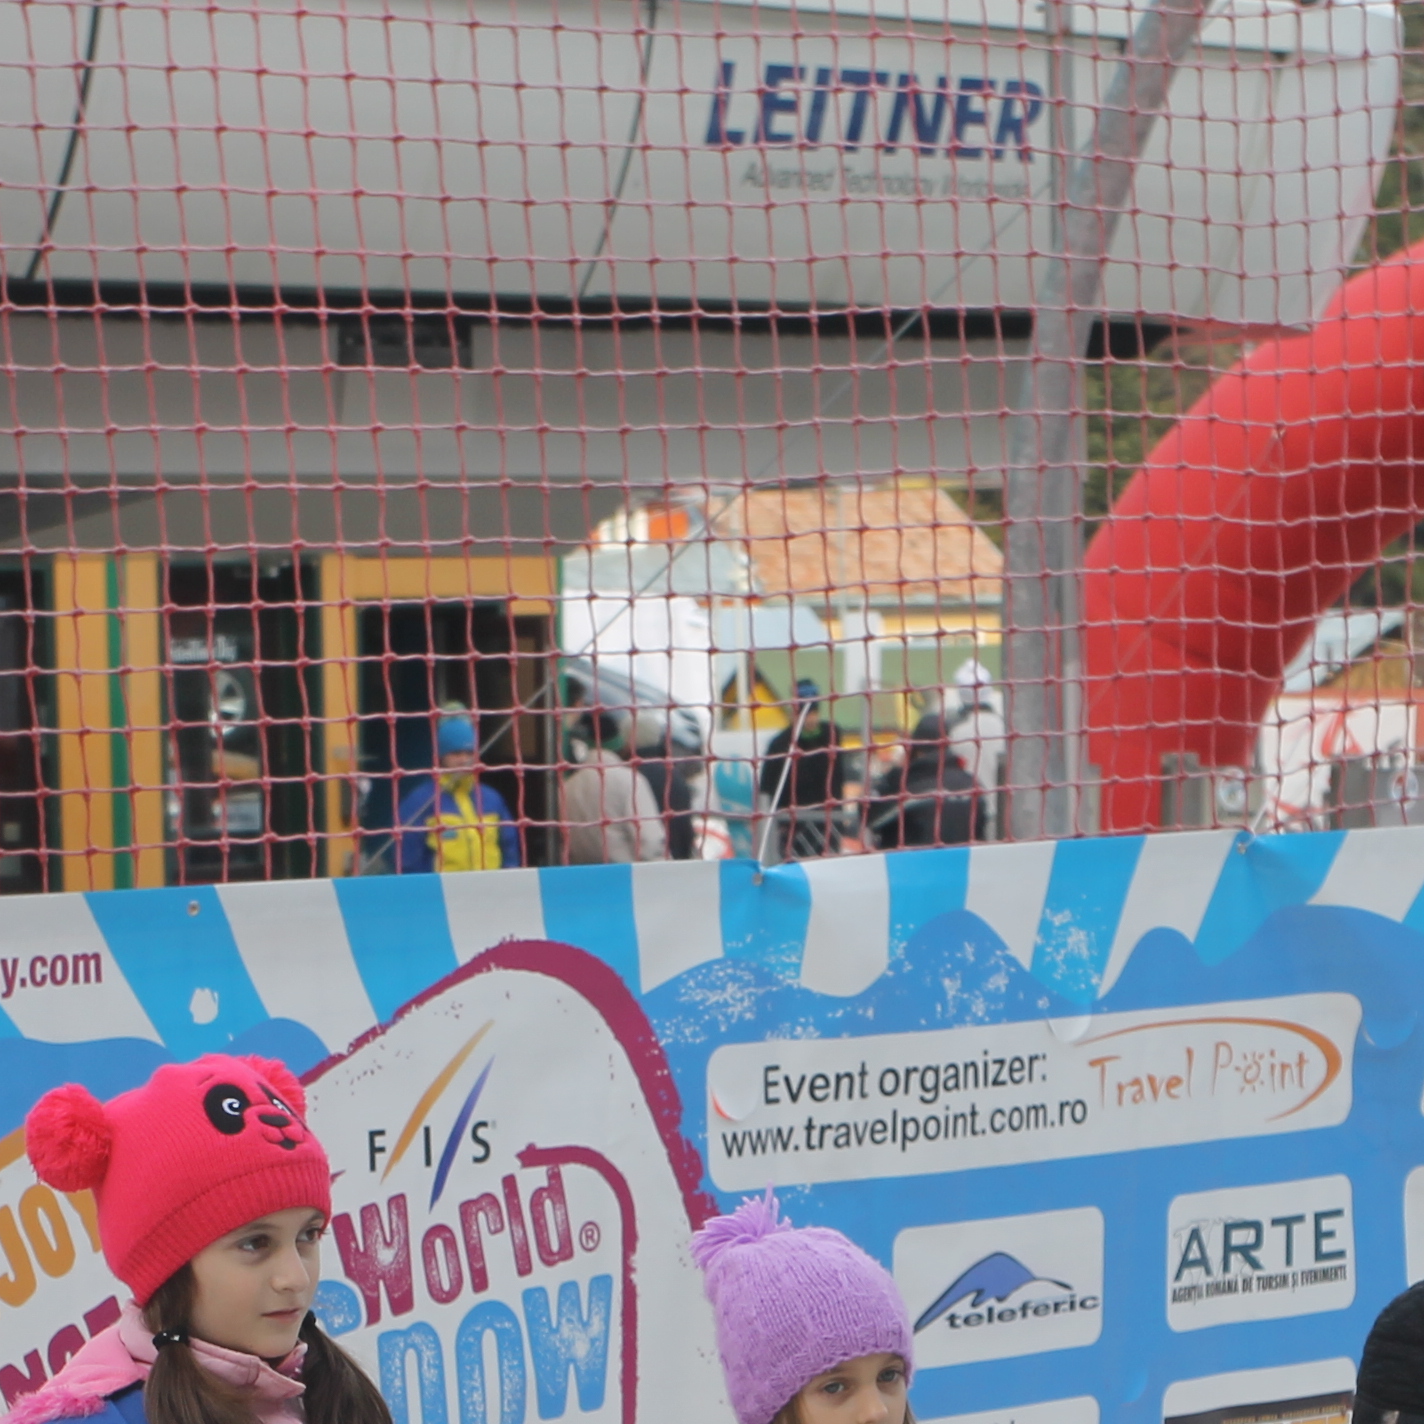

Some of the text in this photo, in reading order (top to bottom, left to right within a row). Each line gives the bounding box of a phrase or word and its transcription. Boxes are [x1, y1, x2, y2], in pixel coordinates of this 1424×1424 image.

[703, 60, 1044, 164] LEITNER
[763, 1050, 1047, 1105] Event organizer:
[1088, 1041, 1310, 1109] Travel Point
[722, 1099, 1089, 1159] www.travelpoint.com.ro
[332, 1164, 575, 1329] World
[1173, 1207, 1347, 1283] ARTE
[945, 1293, 1100, 1330] teleferic
[1241, 1276, 1254, 1294] DE
